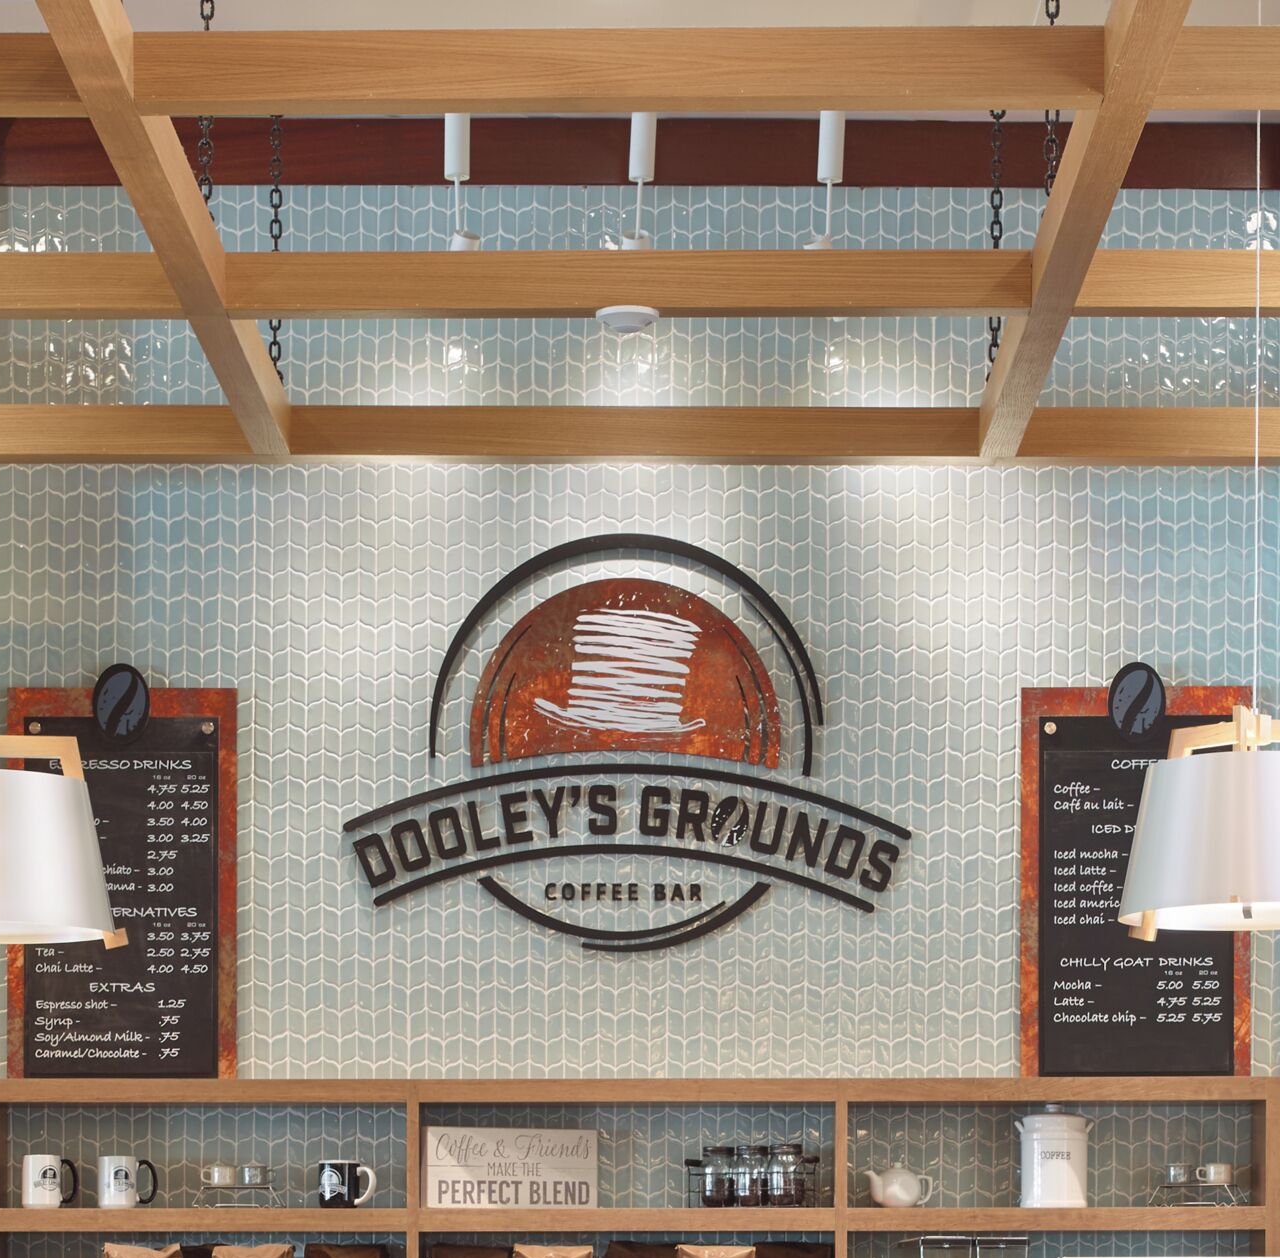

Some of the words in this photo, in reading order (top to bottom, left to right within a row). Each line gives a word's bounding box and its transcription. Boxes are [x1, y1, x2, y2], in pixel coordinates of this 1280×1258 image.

[134, 759, 192, 770] DRINKS
[147, 784, 177, 796] 4.75
[181, 784, 210, 794] 5.25
[1054, 783, 1090, 796] Coffee
[147, 801, 174, 810] 4.00
[181, 801, 208, 810] 4.50
[1054, 798, 1081, 812] Café
[1084, 802, 1099, 810] au
[1103, 799, 1124, 810] lait
[147, 817, 174, 826] 3.50
[181, 817, 207, 826] 4.00
[1092, 824, 1121, 833] ICED
[147, 833, 174, 843] 3.00
[181, 833, 210, 843] 3.25
[352, 784, 619, 890] DOOLEY'S
[147, 850, 177, 862] 2.75
[1054, 849, 1076, 859] Iced
[1080, 849, 1118, 859] mocha
[147, 867, 174, 876] 3.00
[1054, 865, 1076, 876] Iced
[1080, 865, 1106, 875] latte
[147, 883, 174, 892] 3.00
[544, 883, 638, 901] COFFEE
[654, 883, 702, 901] BAR
[1054, 882, 1076, 892] Iced
[1080, 880, 1113, 895] coffee
[1054, 898, 1076, 908] Iced
[1080, 897, 1120, 908] americ
[1054, 914, 1076, 925] Iced
[1080, 913, 1105, 924] chai
[147, 932, 174, 941] 3.50
[181, 932, 211, 943] 3.75
[35, 948, 55, 957] Tea
[147, 948, 175, 957] 2.50
[181, 948, 211, 959] 2.75
[36, 962, 61, 973] Chai
[65, 964, 94, 973] Latte
[147, 964, 173, 973] 4.00
[181, 964, 208, 973] 4.50
[1060, 957, 1110, 971] CHILLY
[1113, 957, 1153, 967] GOAT
[1159, 957, 1214, 966] DRINKS
[90, 983, 156, 992] EXTRAS
[1053, 980, 1091, 990] Mocha
[1157, 980, 1183, 990] 5.00
[1192, 980, 1219, 990] 5.50
[36, 1000, 82, 1013] Espresso
[84, 1000, 108, 1009] shot
[158, 999, 186, 1009] 1.25
[1054, 997, 1084, 1006] Latte
[1157, 997, 1187, 1008] 4.75
[1192, 997, 1222, 1006] 5.25
[35, 1016, 73, 1030] Syrup
[159, 1016, 180, 1027] .75
[1054, 1012, 1109, 1022] Chocolate
[1112, 1010, 1136, 1026] chip
[1156, 1013, 1186, 1022] 5.25
[1192, 1013, 1222, 1024] 5.75
[34, 1032, 111, 1046] Soy/Almond
[114, 1030, 143, 1042] Milk
[159, 1032, 180, 1043] .75
[35, 1048, 139, 1059] Caramel/Chocolate
[159, 1048, 180, 1059] .75
[436, 1133, 488, 1163] Coffee
[494, 1138, 509, 1158] &
[514, 1133, 592, 1160] Friends
[1040, 1151, 1071, 1161] COFFEE
[488, 1162, 518, 1176] MAKE
[522, 1162, 542, 1177] THE
[438, 1180, 522, 1205] PERFECT
[530, 1181, 590, 1206] BLEND
